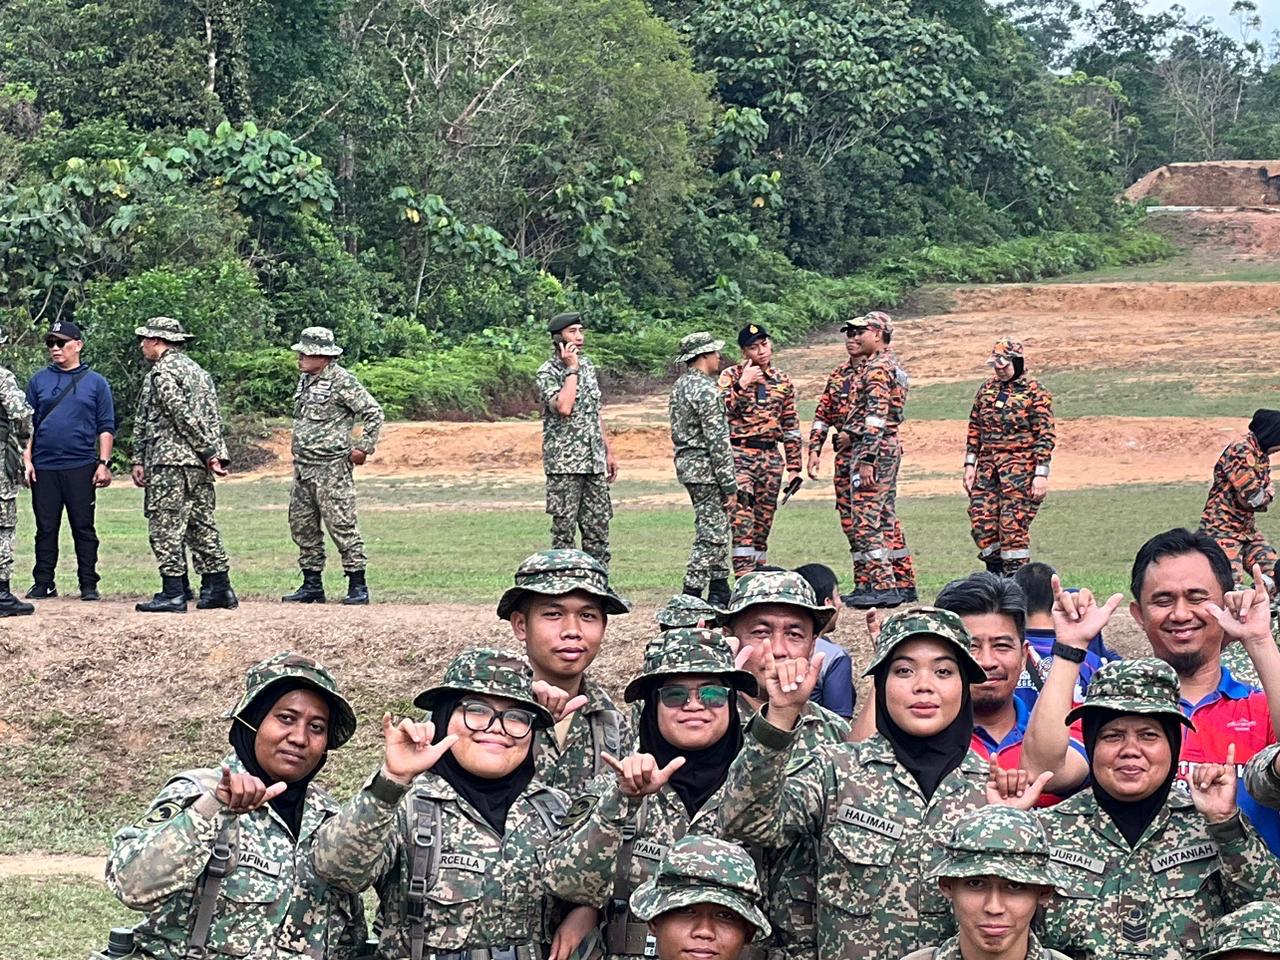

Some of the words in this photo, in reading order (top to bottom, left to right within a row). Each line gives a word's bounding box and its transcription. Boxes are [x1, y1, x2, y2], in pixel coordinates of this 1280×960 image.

[845, 809, 895, 833] HALIMAH
[633, 843, 661, 856] IYANA
[1051, 849, 1092, 867] JURIAH
[1157, 844, 1213, 867] WATANIAH
[239, 853, 269, 870] AFINA
